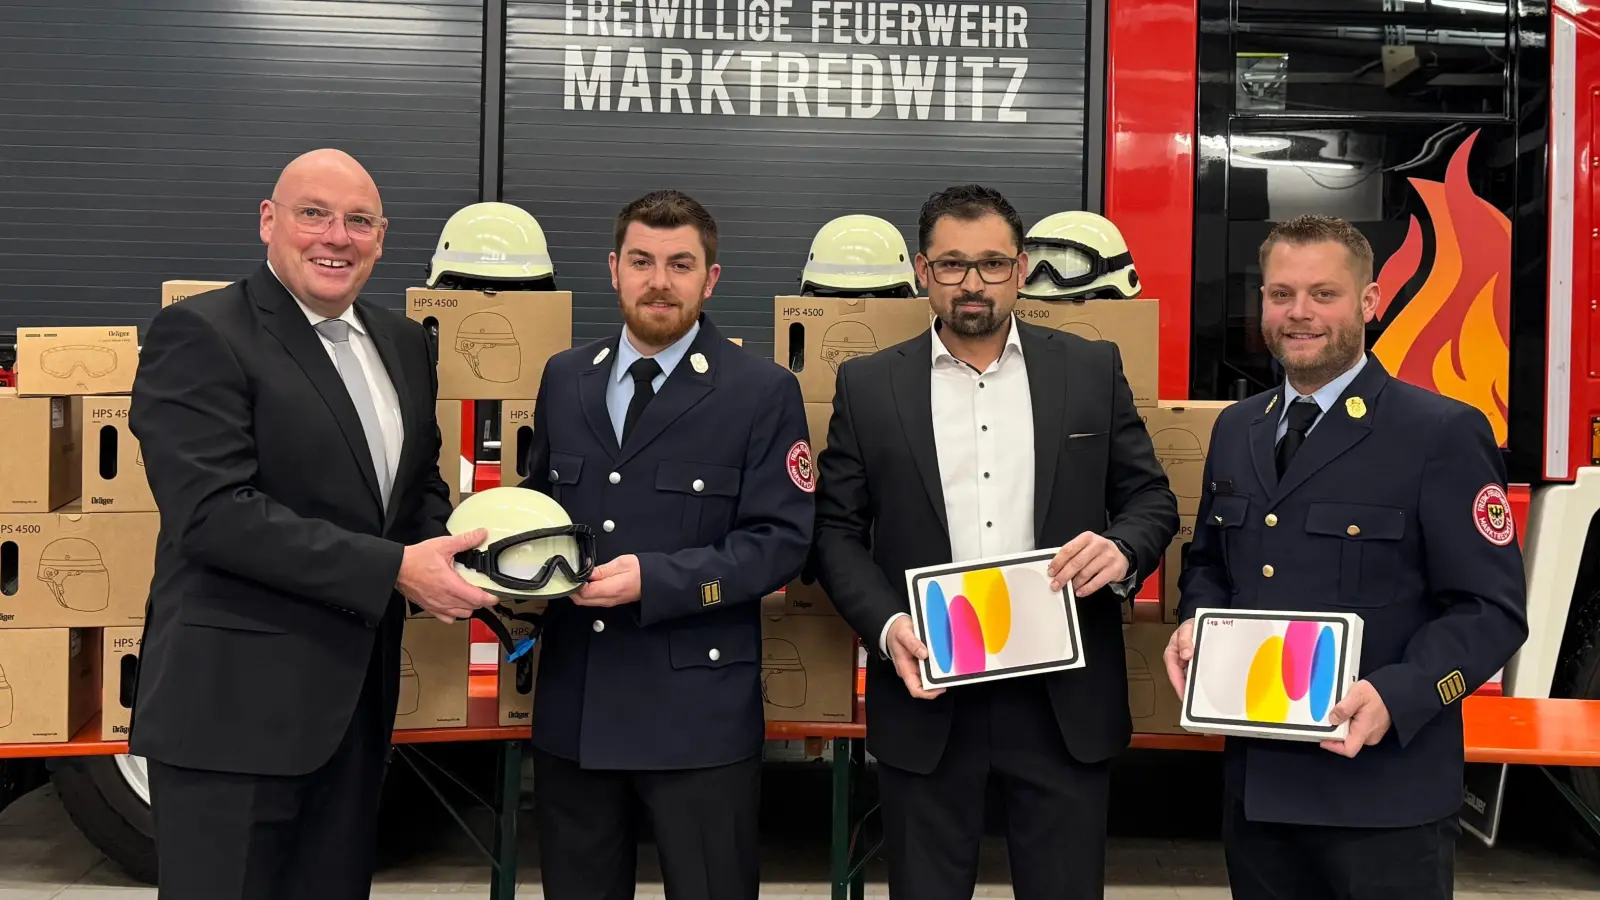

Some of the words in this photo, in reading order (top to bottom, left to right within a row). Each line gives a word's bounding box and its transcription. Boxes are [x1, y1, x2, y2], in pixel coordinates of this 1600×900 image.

[564, 0, 793, 42] FREIWILLIGE
[811, 0, 1028, 48] FEUERWEHR
[563, 44, 1029, 123] MARKTREDWITZ
[171, 295, 191, 304] HP
[413, 298, 433, 307] HPS
[434, 299, 458, 308] 4500
[783, 307, 801, 316] HPS
[802, 308, 824, 317] 4500
[1014, 310, 1026, 318] PS
[1027, 310, 1050, 318] 4500
[92, 408, 113, 419] HPS
[114, 409, 129, 419] 45
[510, 410, 529, 419] HPS
[91, 496, 114, 505] Dräger
[0, 524, 13, 533] PS
[15, 524, 41, 534] 4500
[0, 613, 15, 621] äger
[114, 638, 134, 648] HPS
[112, 725, 130, 735] Dräg
